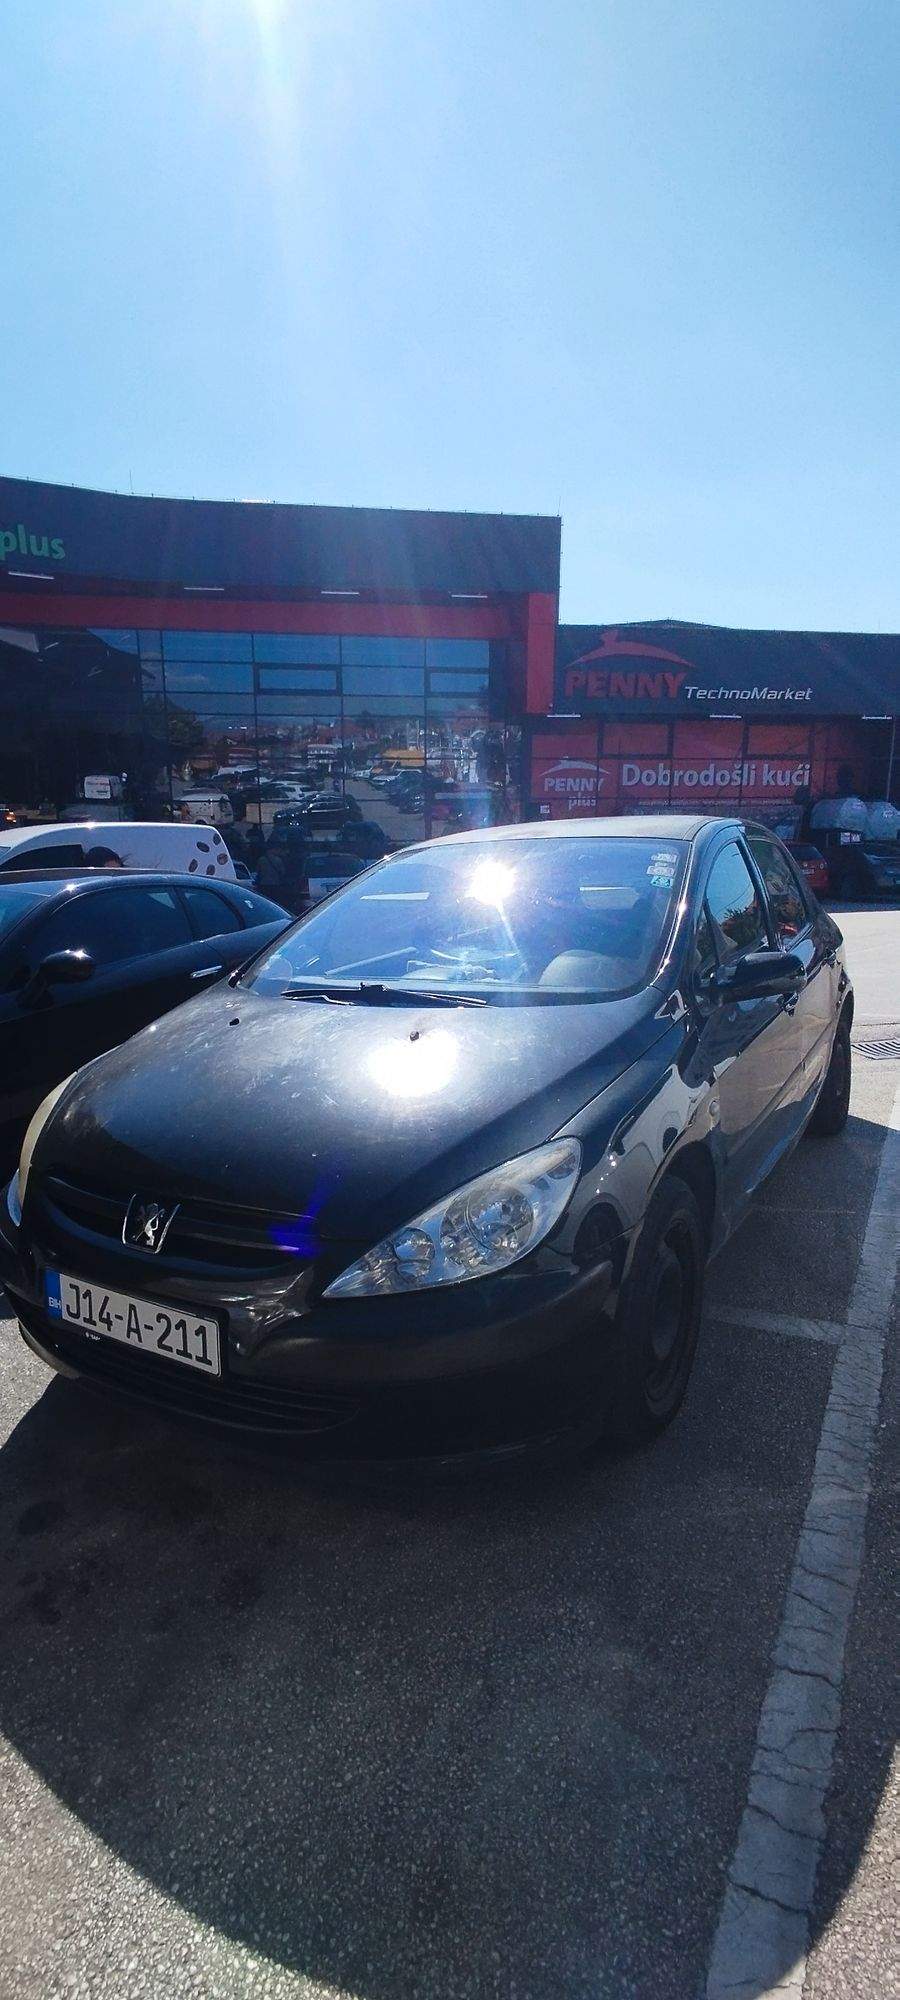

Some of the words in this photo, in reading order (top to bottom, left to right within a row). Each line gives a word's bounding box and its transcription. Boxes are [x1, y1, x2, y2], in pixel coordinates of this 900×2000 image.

[0, 524, 66, 561] plus
[564, 671, 688, 699] PENNY
[684, 686, 813, 701] TechnoMarket
[543, 777, 604, 793] PENNY
[622, 763, 756, 787] Dobrodošli
[762, 764, 811, 788] kući
[65, 1283, 213, 1367] J14-A-211
